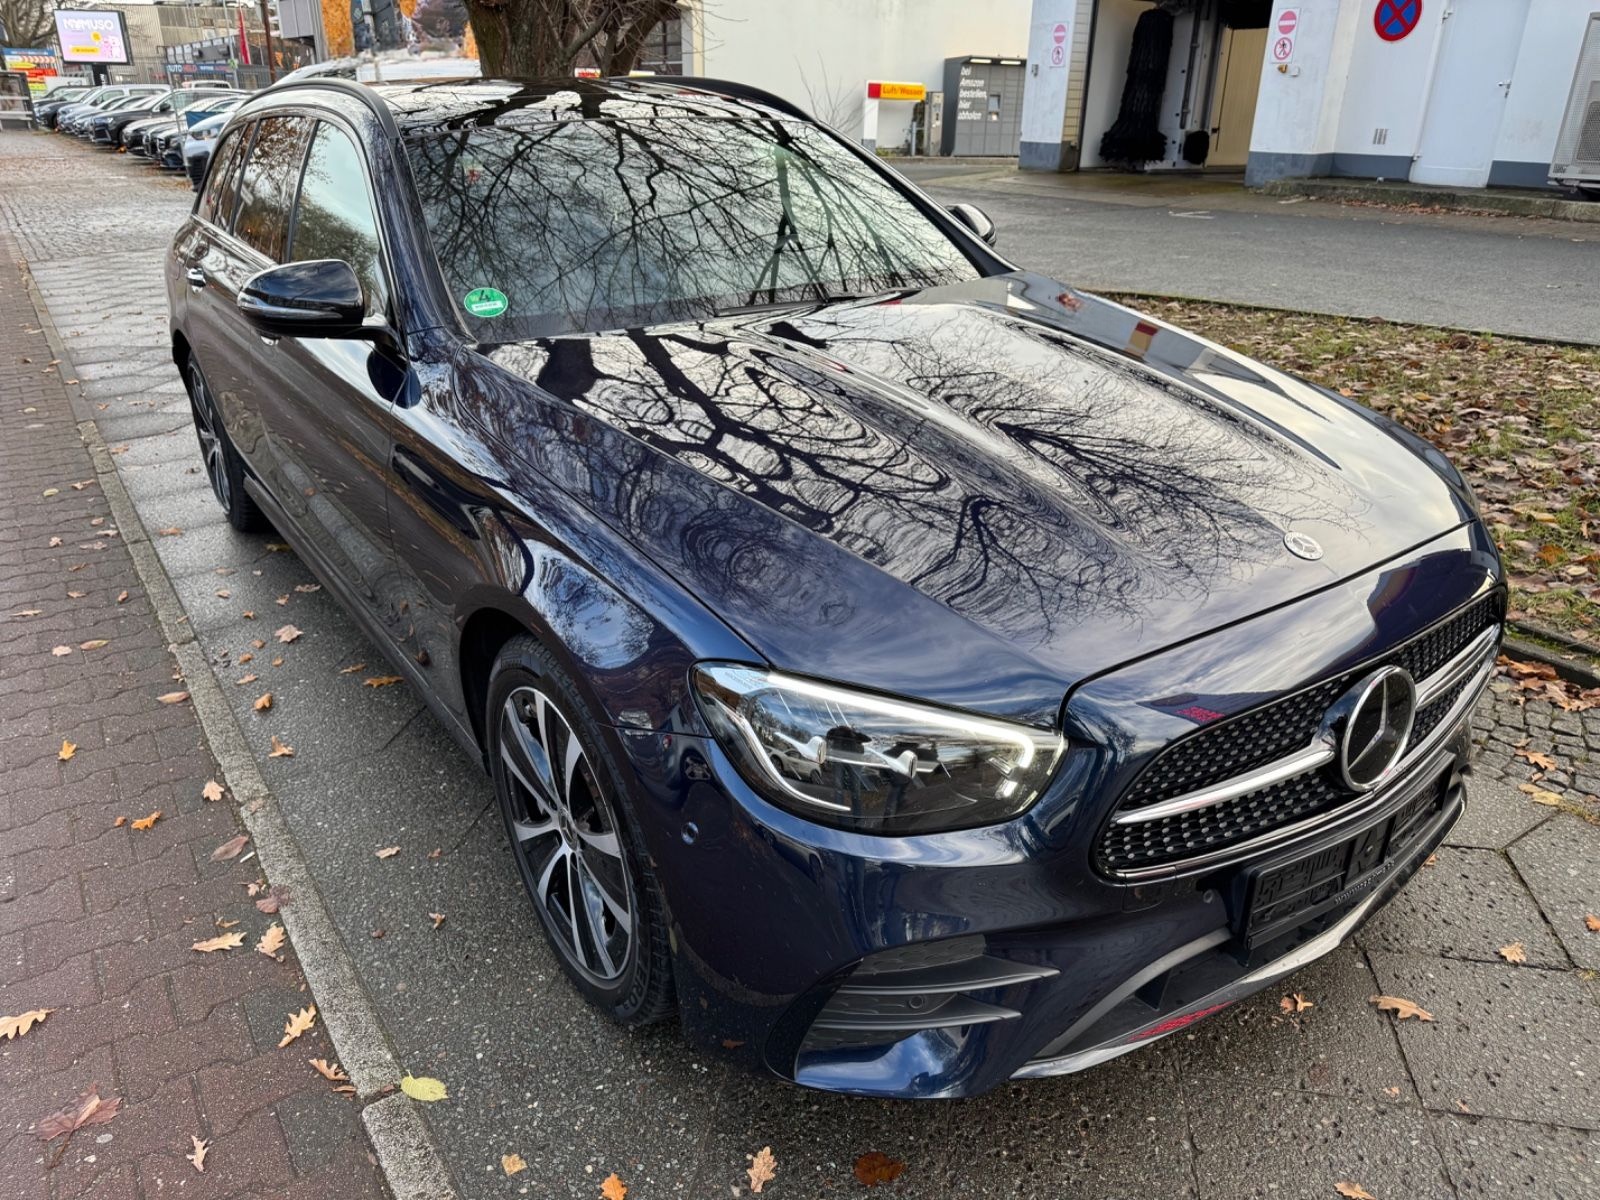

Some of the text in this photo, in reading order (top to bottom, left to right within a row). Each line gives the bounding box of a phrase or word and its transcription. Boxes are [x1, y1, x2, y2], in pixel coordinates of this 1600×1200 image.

[959, 77, 985, 87] Amazon
[958, 100, 972, 109] hier
[957, 110, 982, 120] abholen
